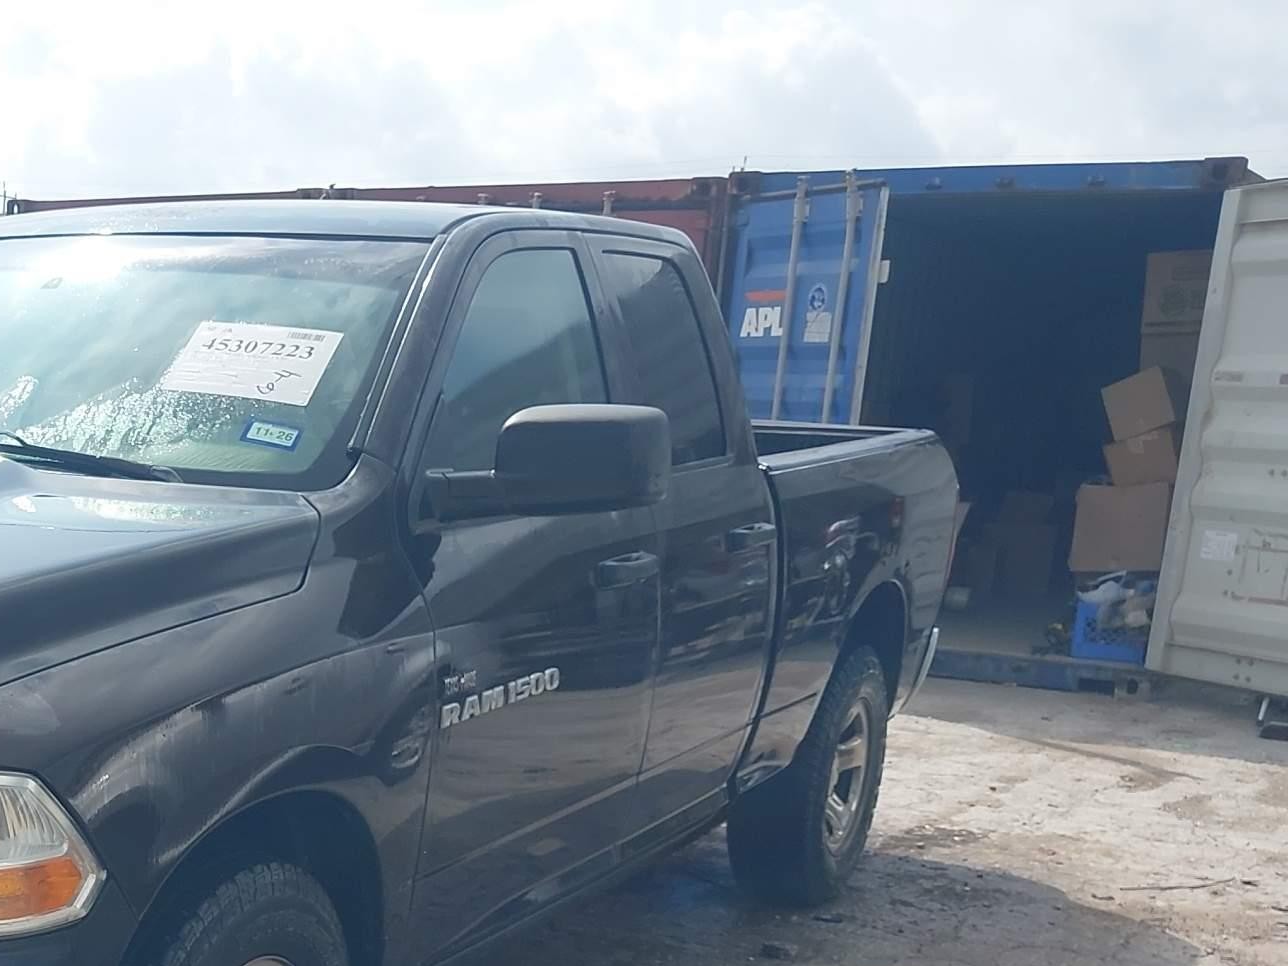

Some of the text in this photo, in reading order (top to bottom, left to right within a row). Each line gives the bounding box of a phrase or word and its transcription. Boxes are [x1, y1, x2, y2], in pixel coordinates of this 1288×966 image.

[739, 306, 783, 337] APL
[201, 338, 315, 360] 45307223
[439, 685, 505, 729] RAM
[507, 667, 561, 704] 1500
